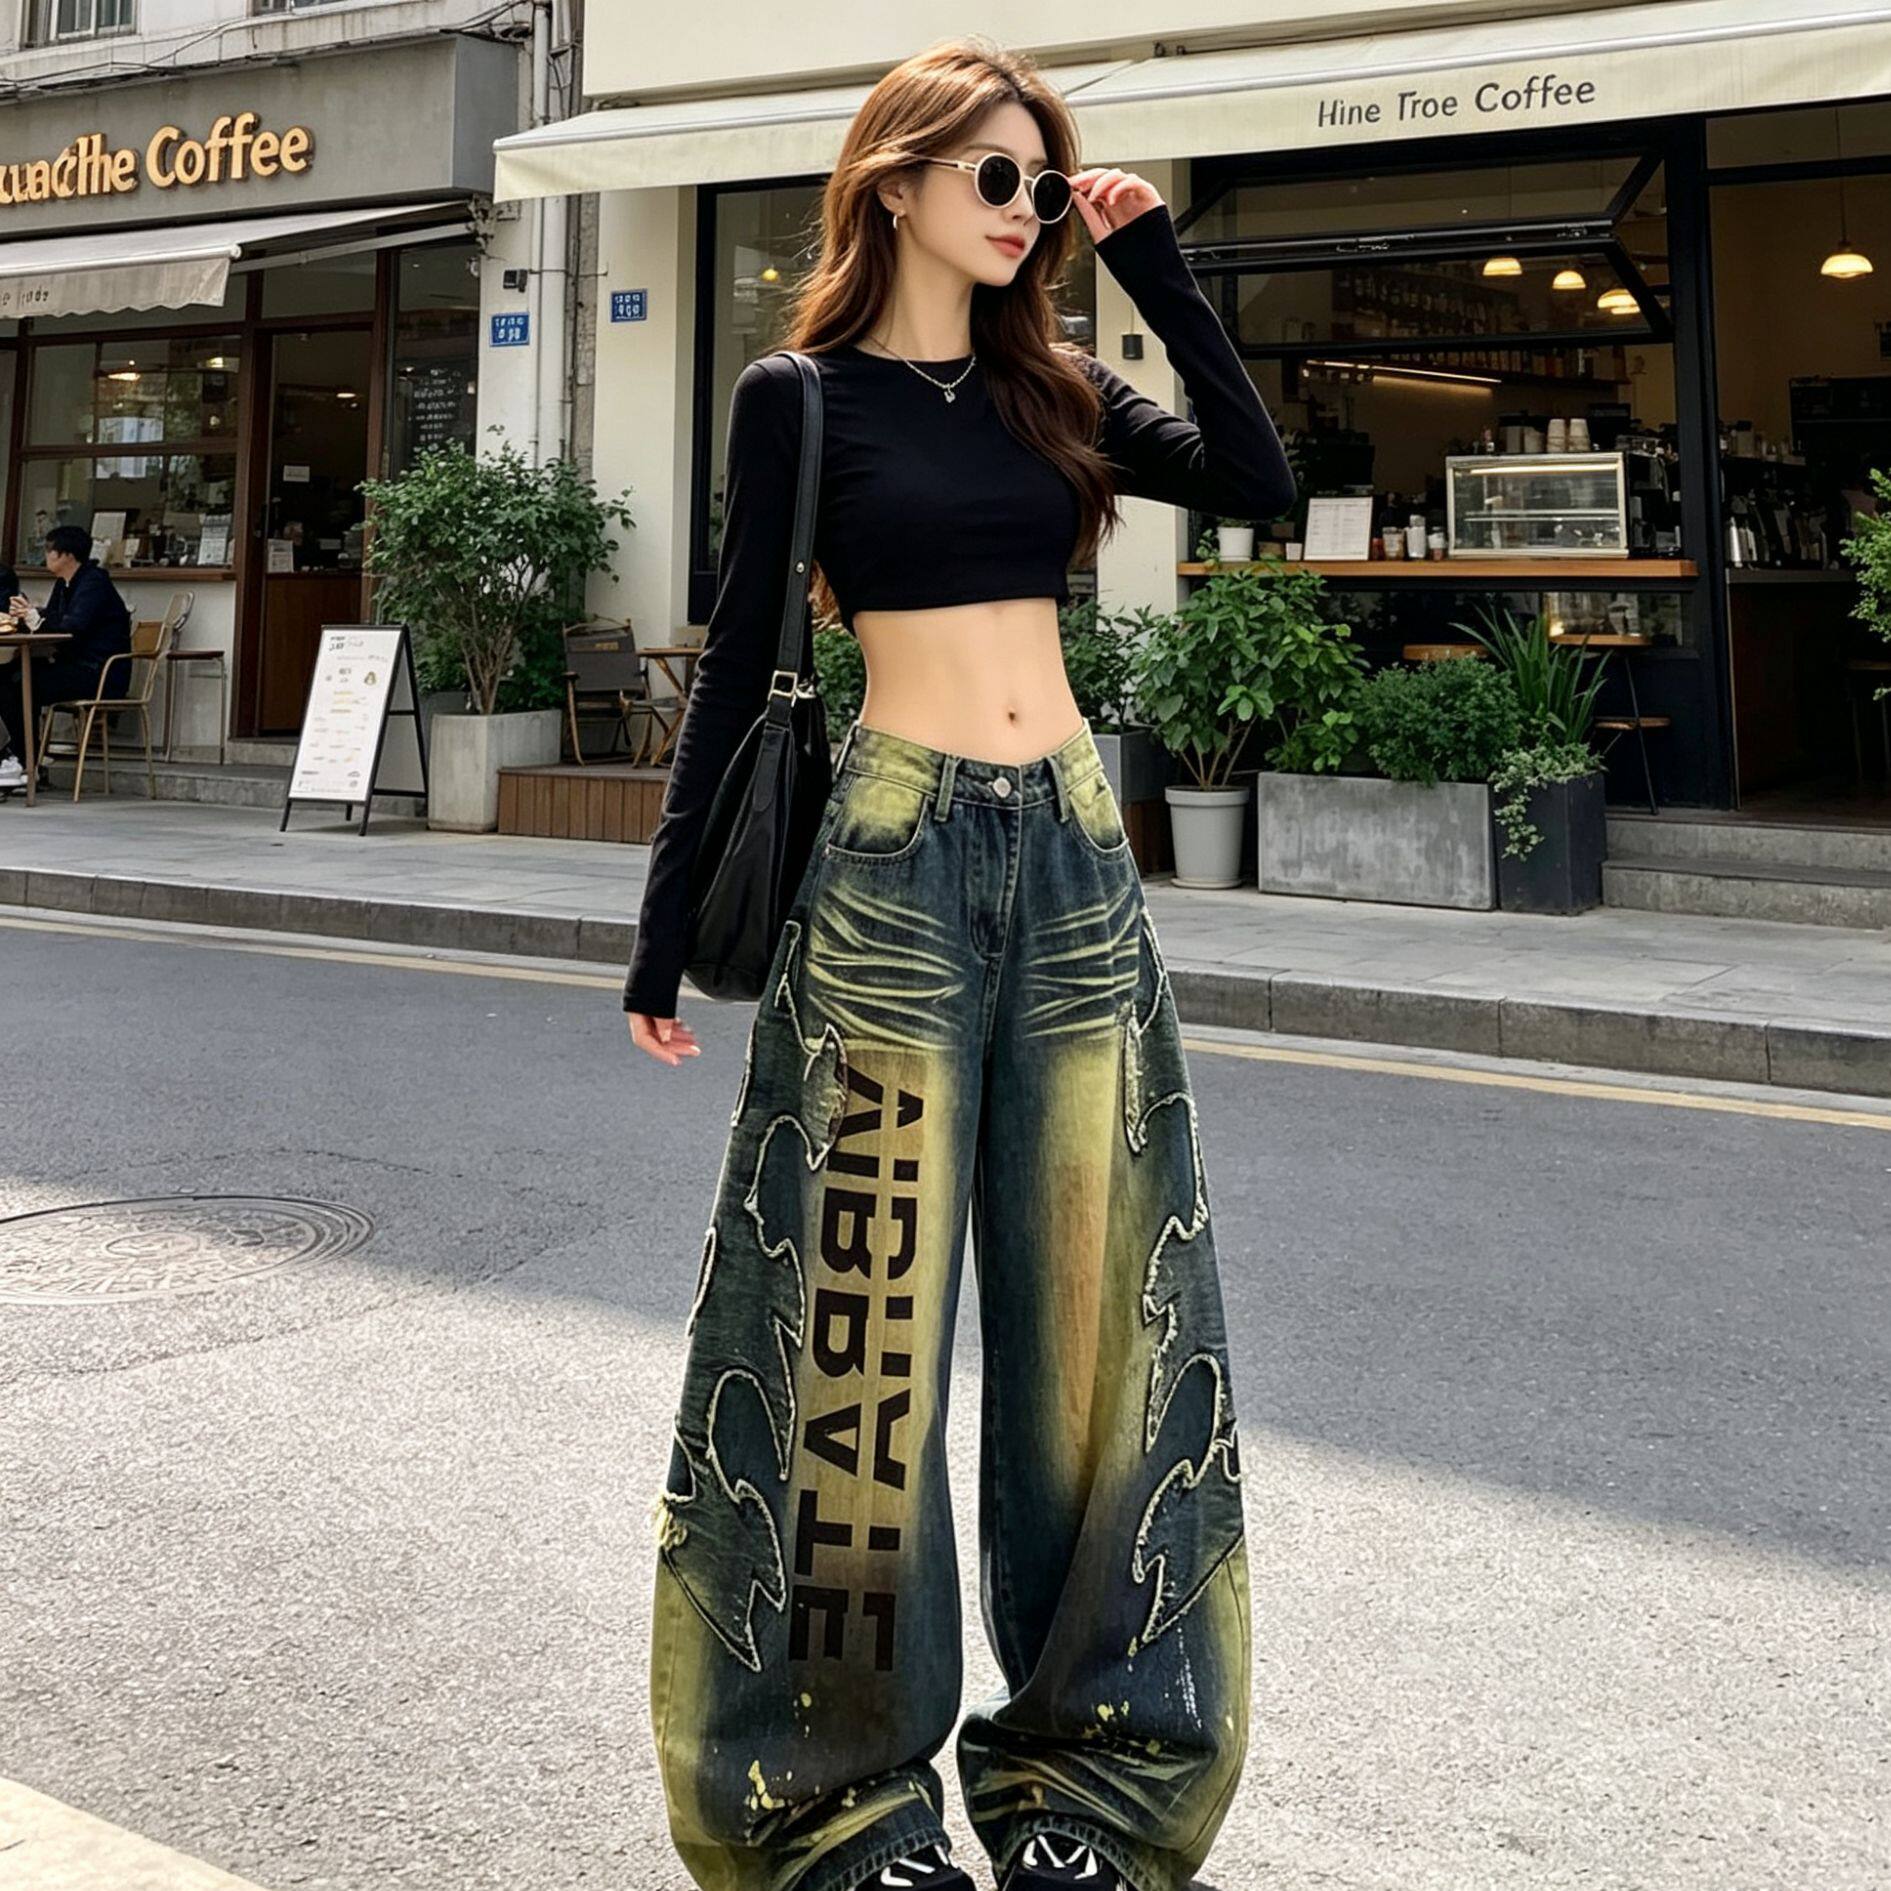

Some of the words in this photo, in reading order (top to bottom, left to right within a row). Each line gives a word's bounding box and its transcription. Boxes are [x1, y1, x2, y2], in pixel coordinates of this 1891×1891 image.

[1318, 99, 1381, 127] Hine
[1475, 74, 1596, 113] Coffee
[145, 111, 311, 188] Coffee
